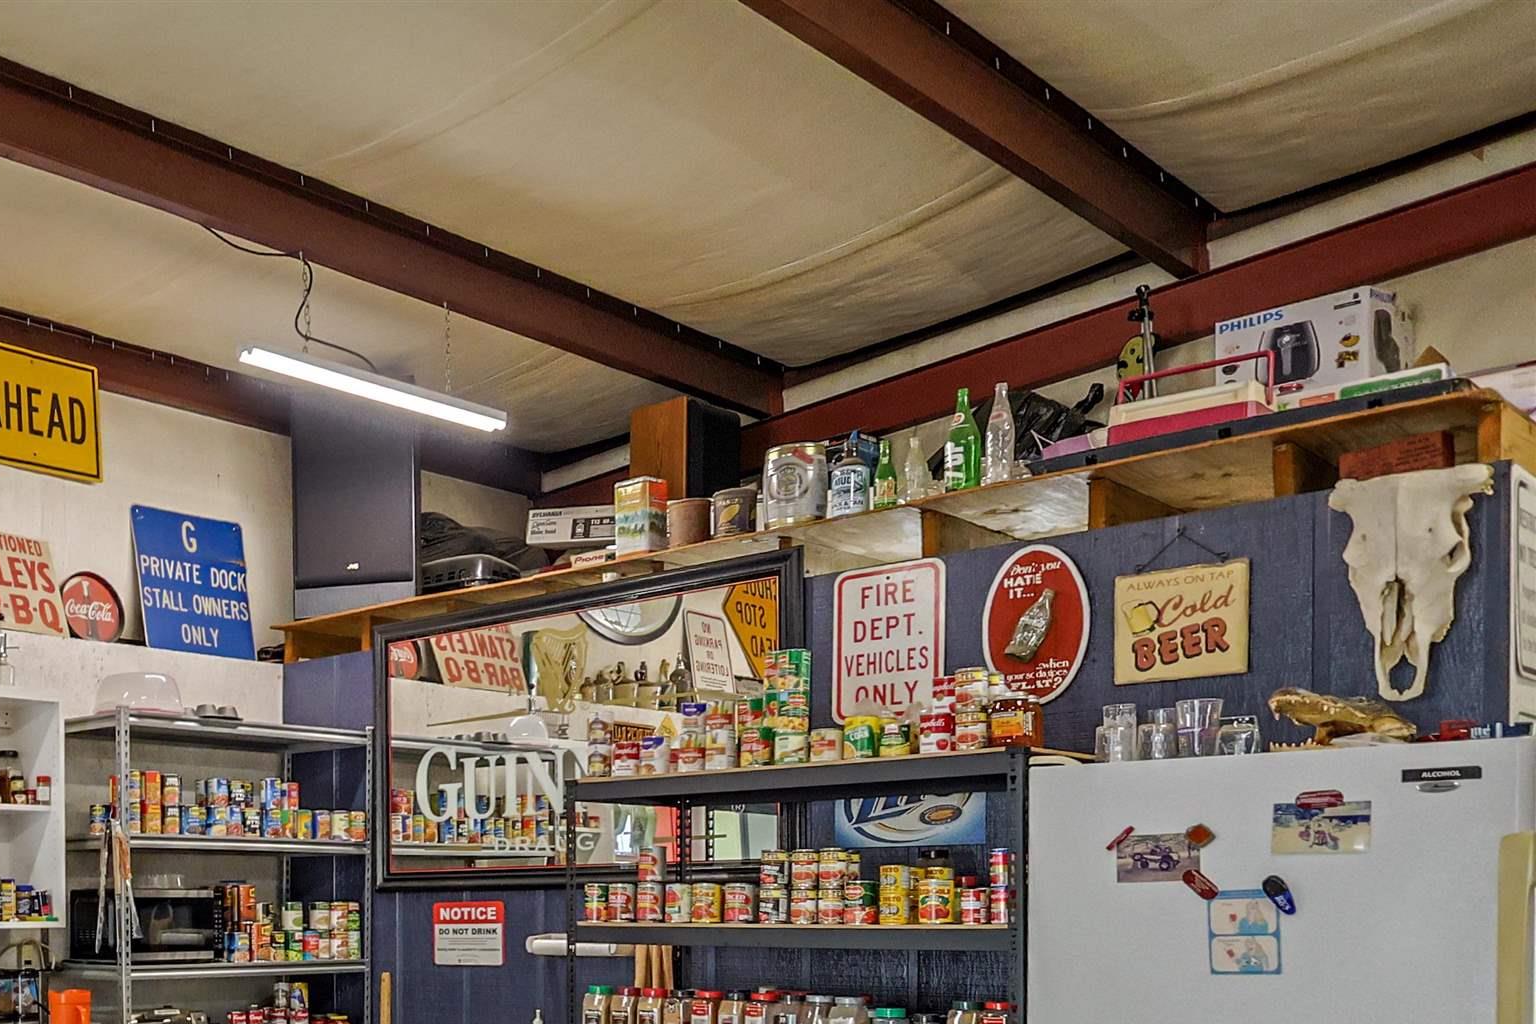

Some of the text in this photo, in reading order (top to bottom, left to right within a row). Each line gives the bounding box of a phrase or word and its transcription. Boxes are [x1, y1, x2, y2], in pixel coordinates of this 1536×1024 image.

[1219, 309, 1284, 336] PHILIPS
[181, 520, 198, 553] G
[140, 554, 247, 592] PRIVATE DOCK
[1003, 571, 1043, 588] HATE
[1038, 560, 1063, 574] you
[861, 579, 915, 609] FIRE
[1127, 569, 1235, 593] ALWAYS ON TAP
[144, 586, 249, 622] STALL OWNERS
[1156, 584, 1234, 628] Cold
[181, 623, 219, 648] ONLY
[1131, 617, 1230, 672] BEER
[844, 646, 929, 677] VEHICLES
[855, 680, 919, 706] ONLY
[1421, 769, 1462, 779] ALCOHOL
[439, 906, 497, 920] NOTICE
[438, 927, 499, 936] DO NOT DRINK
